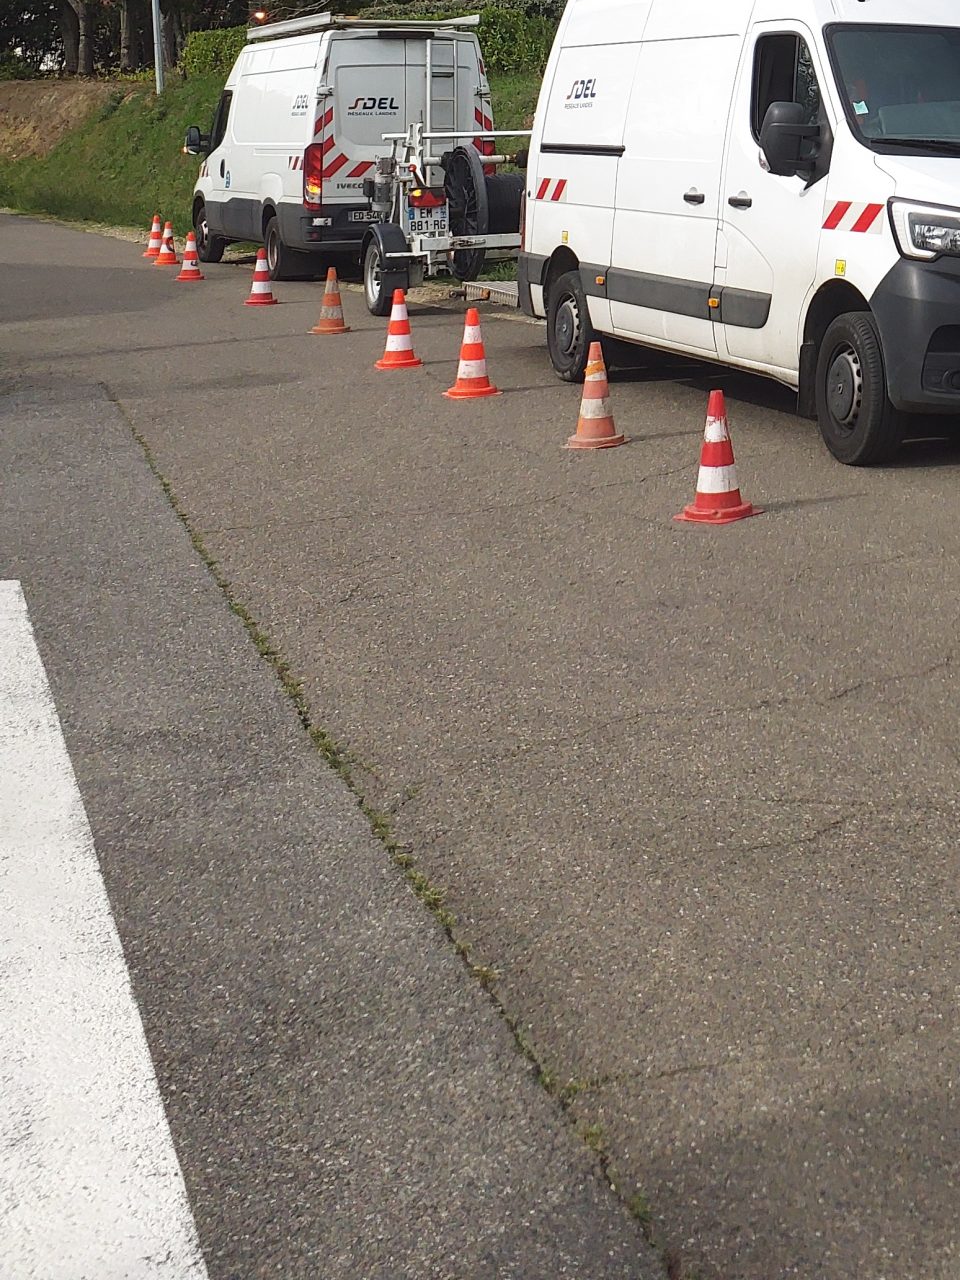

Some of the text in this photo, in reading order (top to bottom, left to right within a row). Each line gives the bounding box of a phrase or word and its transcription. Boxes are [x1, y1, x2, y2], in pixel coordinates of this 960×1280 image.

[566, 78, 597, 100] SDEL
[348, 97, 399, 110] SDEL
[410, 220, 446, 231] 881-RG
